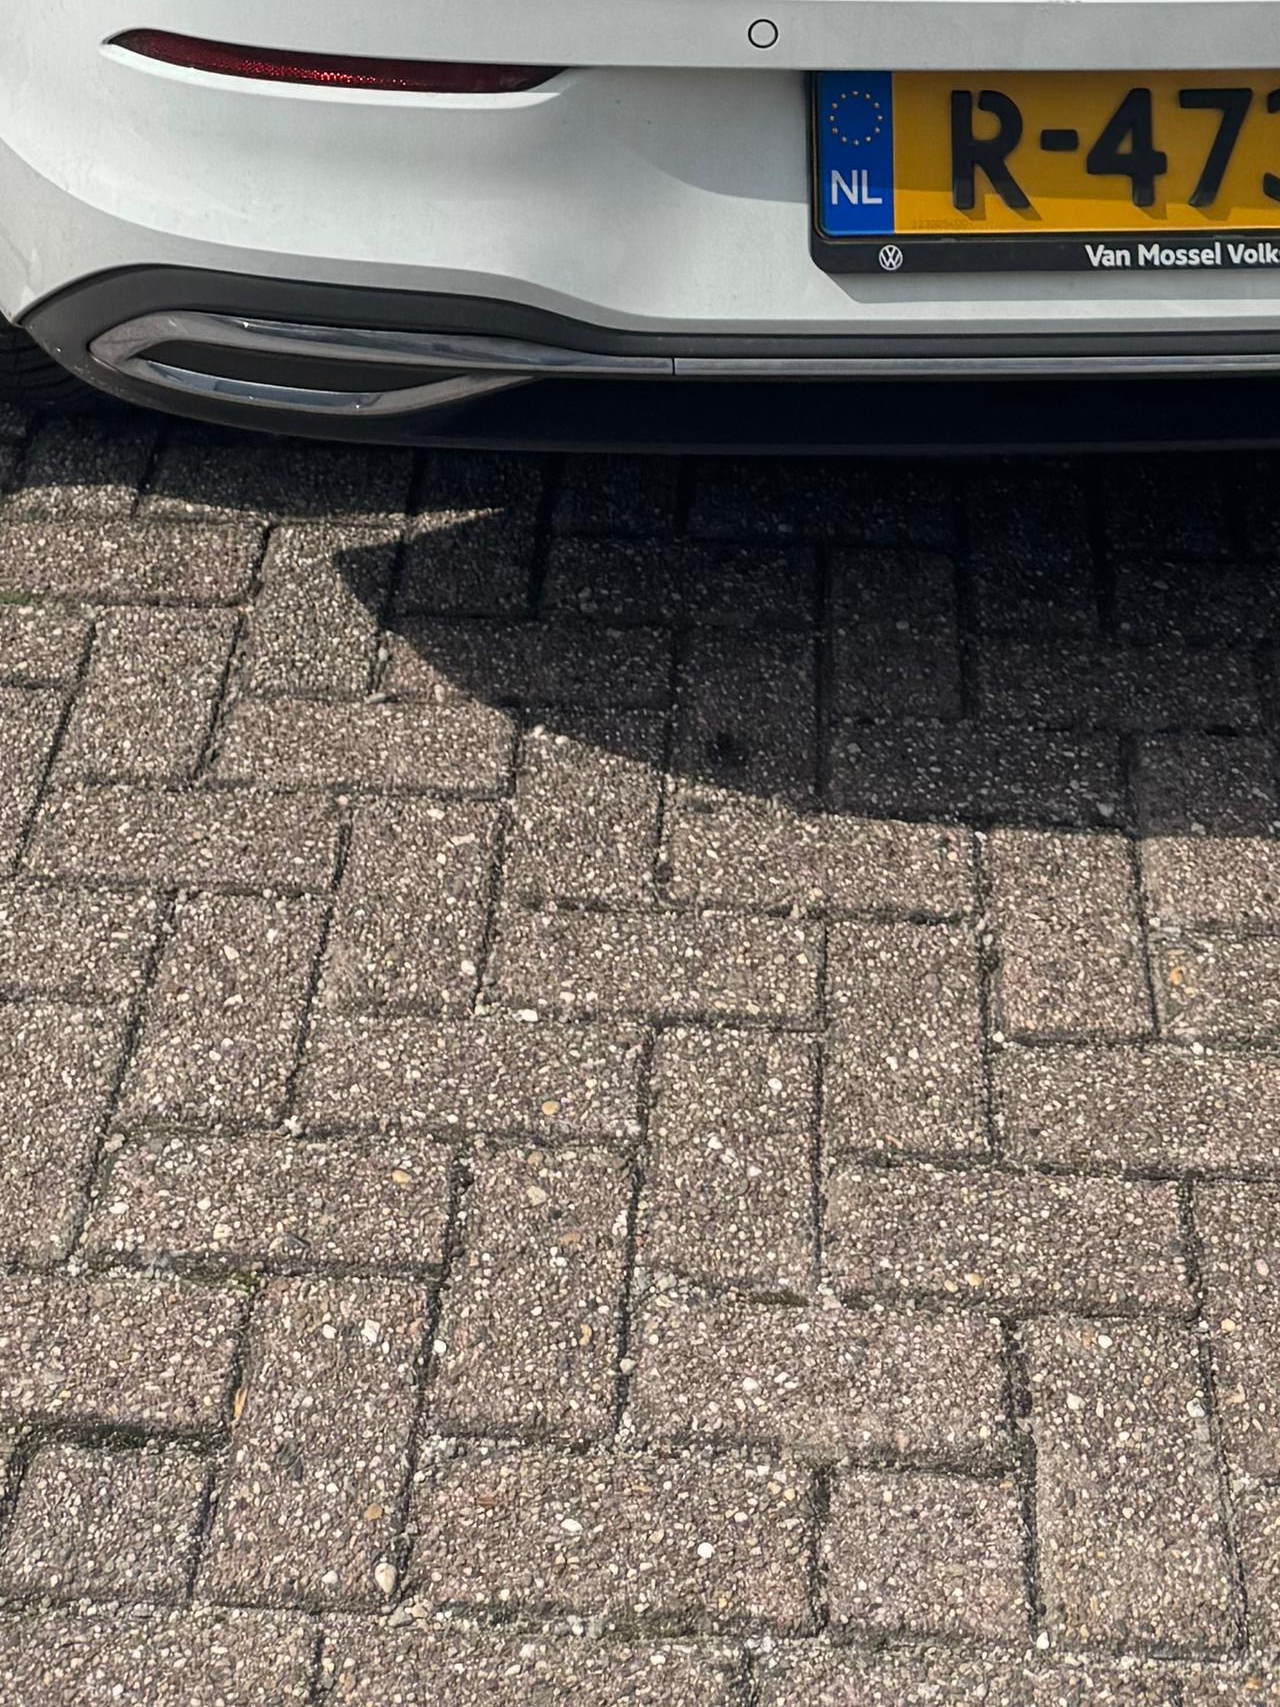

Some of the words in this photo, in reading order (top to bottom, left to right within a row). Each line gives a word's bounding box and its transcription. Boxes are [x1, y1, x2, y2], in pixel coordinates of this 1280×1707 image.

[830, 169, 883, 205] NL
[1085, 243, 1131, 267] Van
[1137, 242, 1221, 266] Mossel
